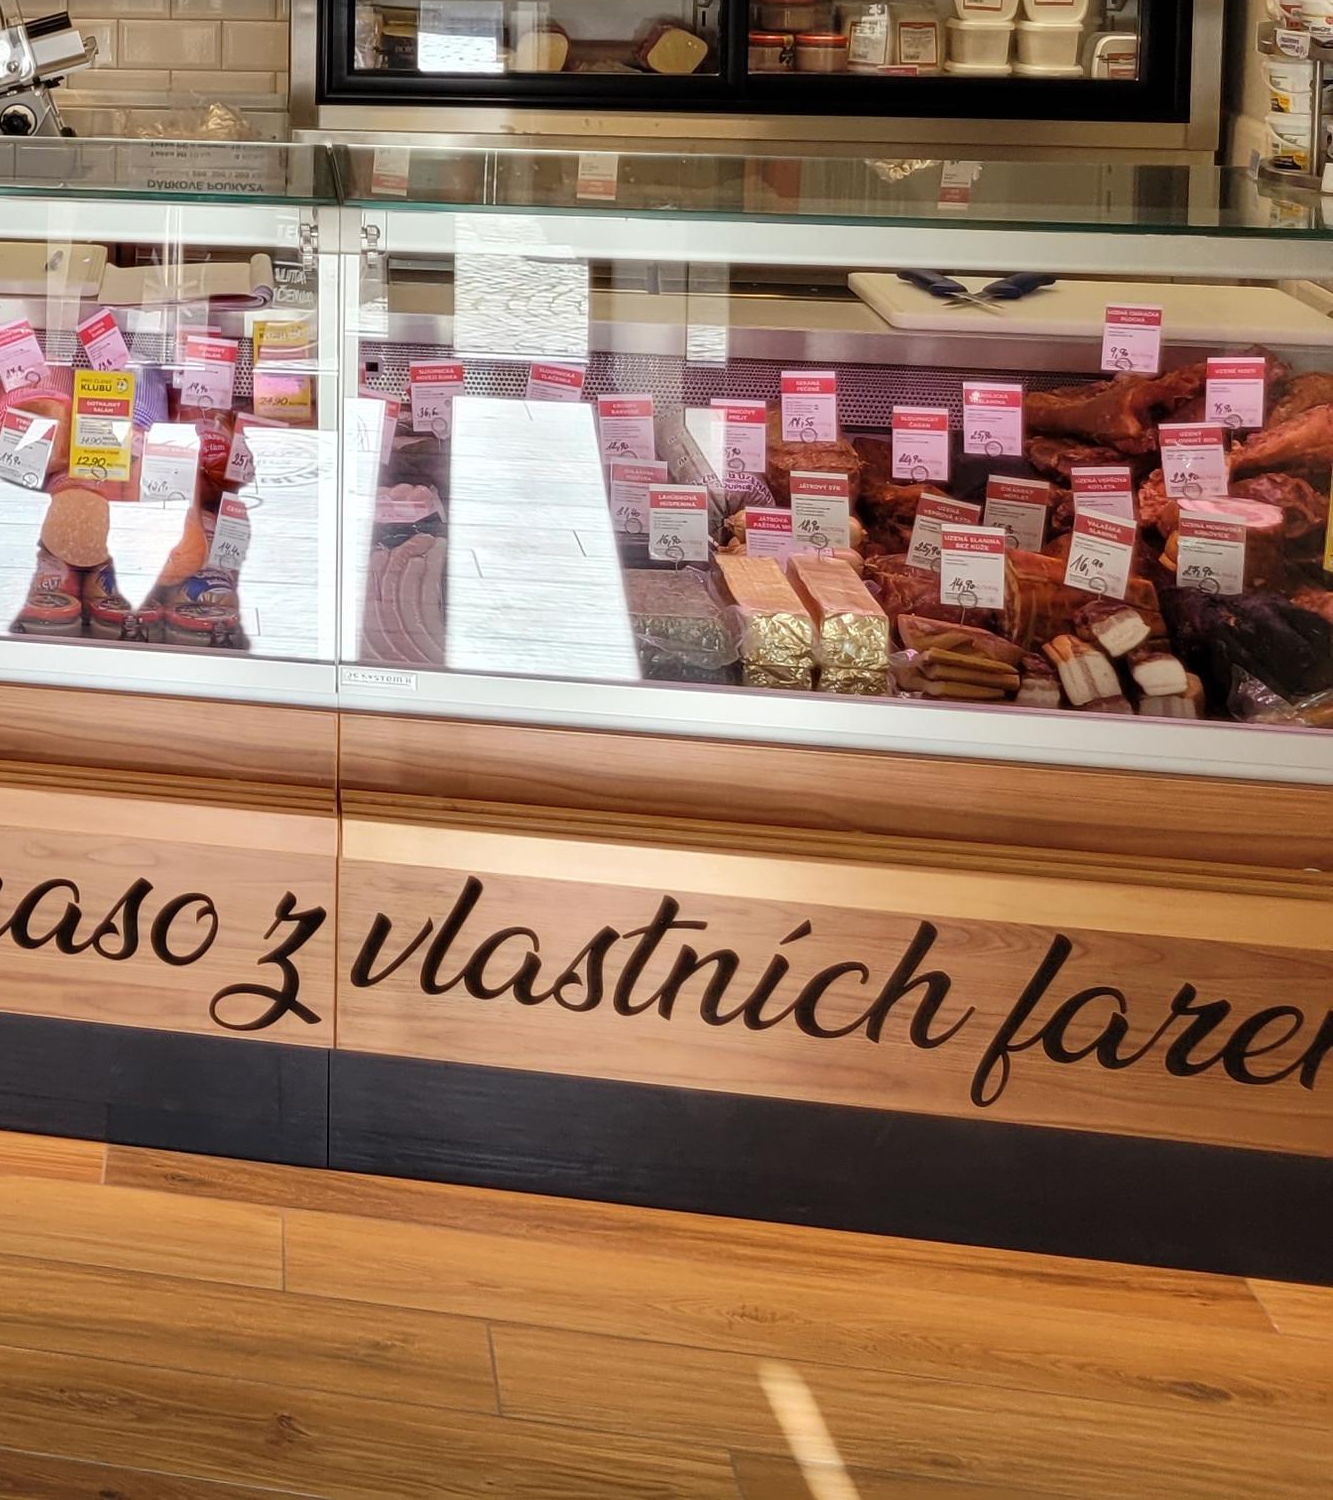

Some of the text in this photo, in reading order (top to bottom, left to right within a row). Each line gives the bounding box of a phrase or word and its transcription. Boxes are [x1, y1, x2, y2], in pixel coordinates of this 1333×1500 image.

[80, 384, 113, 393] KLUBU
[209, 891, 327, 1031] z
[350, 875, 973, 1048] vlastních
